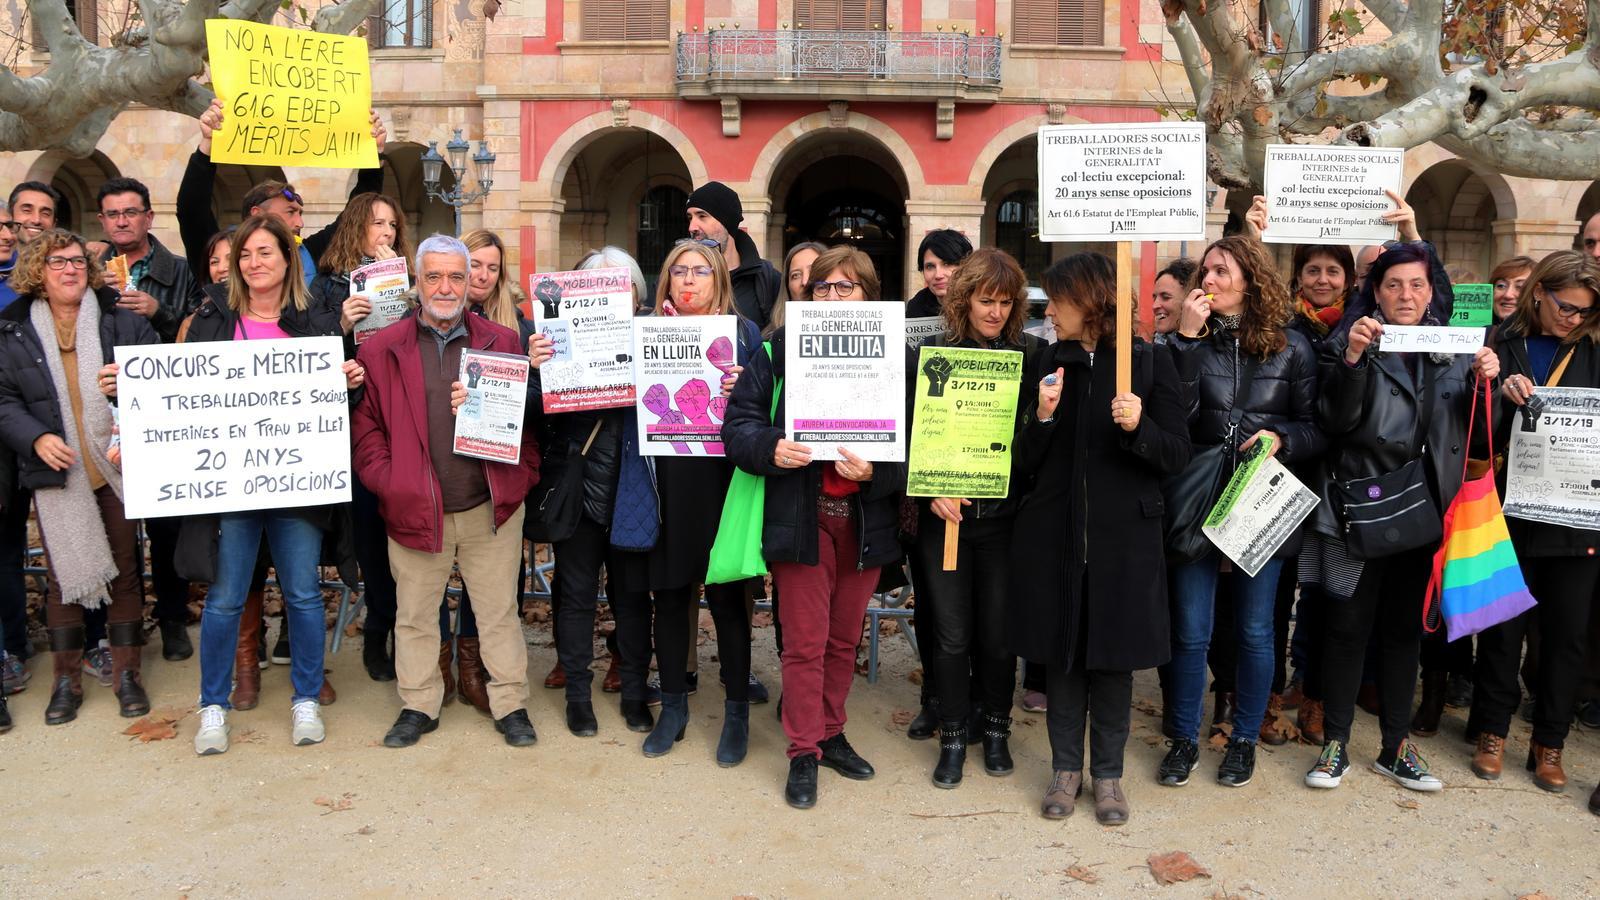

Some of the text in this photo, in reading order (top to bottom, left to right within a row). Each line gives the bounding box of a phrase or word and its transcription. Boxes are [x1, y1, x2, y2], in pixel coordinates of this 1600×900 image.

[226, 28, 344, 66] NO A L'ERE
[250, 59, 361, 94] ENCOBERT
[287, 96, 341, 124] EBEP
[1046, 134, 1200, 144] TREBALLADORES SOCIALS
[1084, 147, 1141, 155] INTERINES
[1143, 147, 1153, 155] de
[1085, 158, 1161, 167] GENERALITAT
[1271, 153, 1399, 164] TREBALLADORES SOCIALS
[1302, 164, 1349, 172] INTERINES
[1117, 170, 1185, 184] excepcional:
[1303, 175, 1365, 183] GENERALITAT
[1055, 187, 1191, 200] 20 anys sense oposicions
[1328, 187, 1385, 197] excepcional:
[1276, 197, 1287, 206] 20
[1290, 199, 1310, 208] anys
[1341, 200, 1388, 210] oposicions
[1126, 209, 1167, 218] l'Empleat
[1298, 216, 1322, 224] Estatut
[565, 297, 608, 309] 3/12/19
[802, 310, 883, 318] TREBALLADORES SOCIALS
[801, 321, 882, 332] DE LA GENERALITAT
[657, 335, 701, 343] GENERALITAT
[1416, 334, 1441, 344] AND
[1449, 334, 1480, 343] TALK
[802, 336, 883, 356] EN LLUITA
[644, 345, 701, 359] EN LLUITA
[125, 355, 220, 380] CONCURS
[226, 367, 245, 380] DE
[482, 378, 510, 388] 3/12/19
[952, 381, 996, 391] 3/12/19
[130, 397, 140, 410] A
[162, 391, 301, 410] TREBALLADORES
[1545, 396, 1600, 407] MOBILITZ
[802, 420, 824, 429] ATUREM
[826, 420, 833, 429] LA
[879, 420, 886, 429] JA
[1544, 416, 1593, 427] 3/12/19
[230, 425, 246, 439] EN
[298, 422, 312, 434] DE
[195, 448, 303, 471] 20 ANYS
[158, 470, 347, 501] SENSE OPOSICIONS
